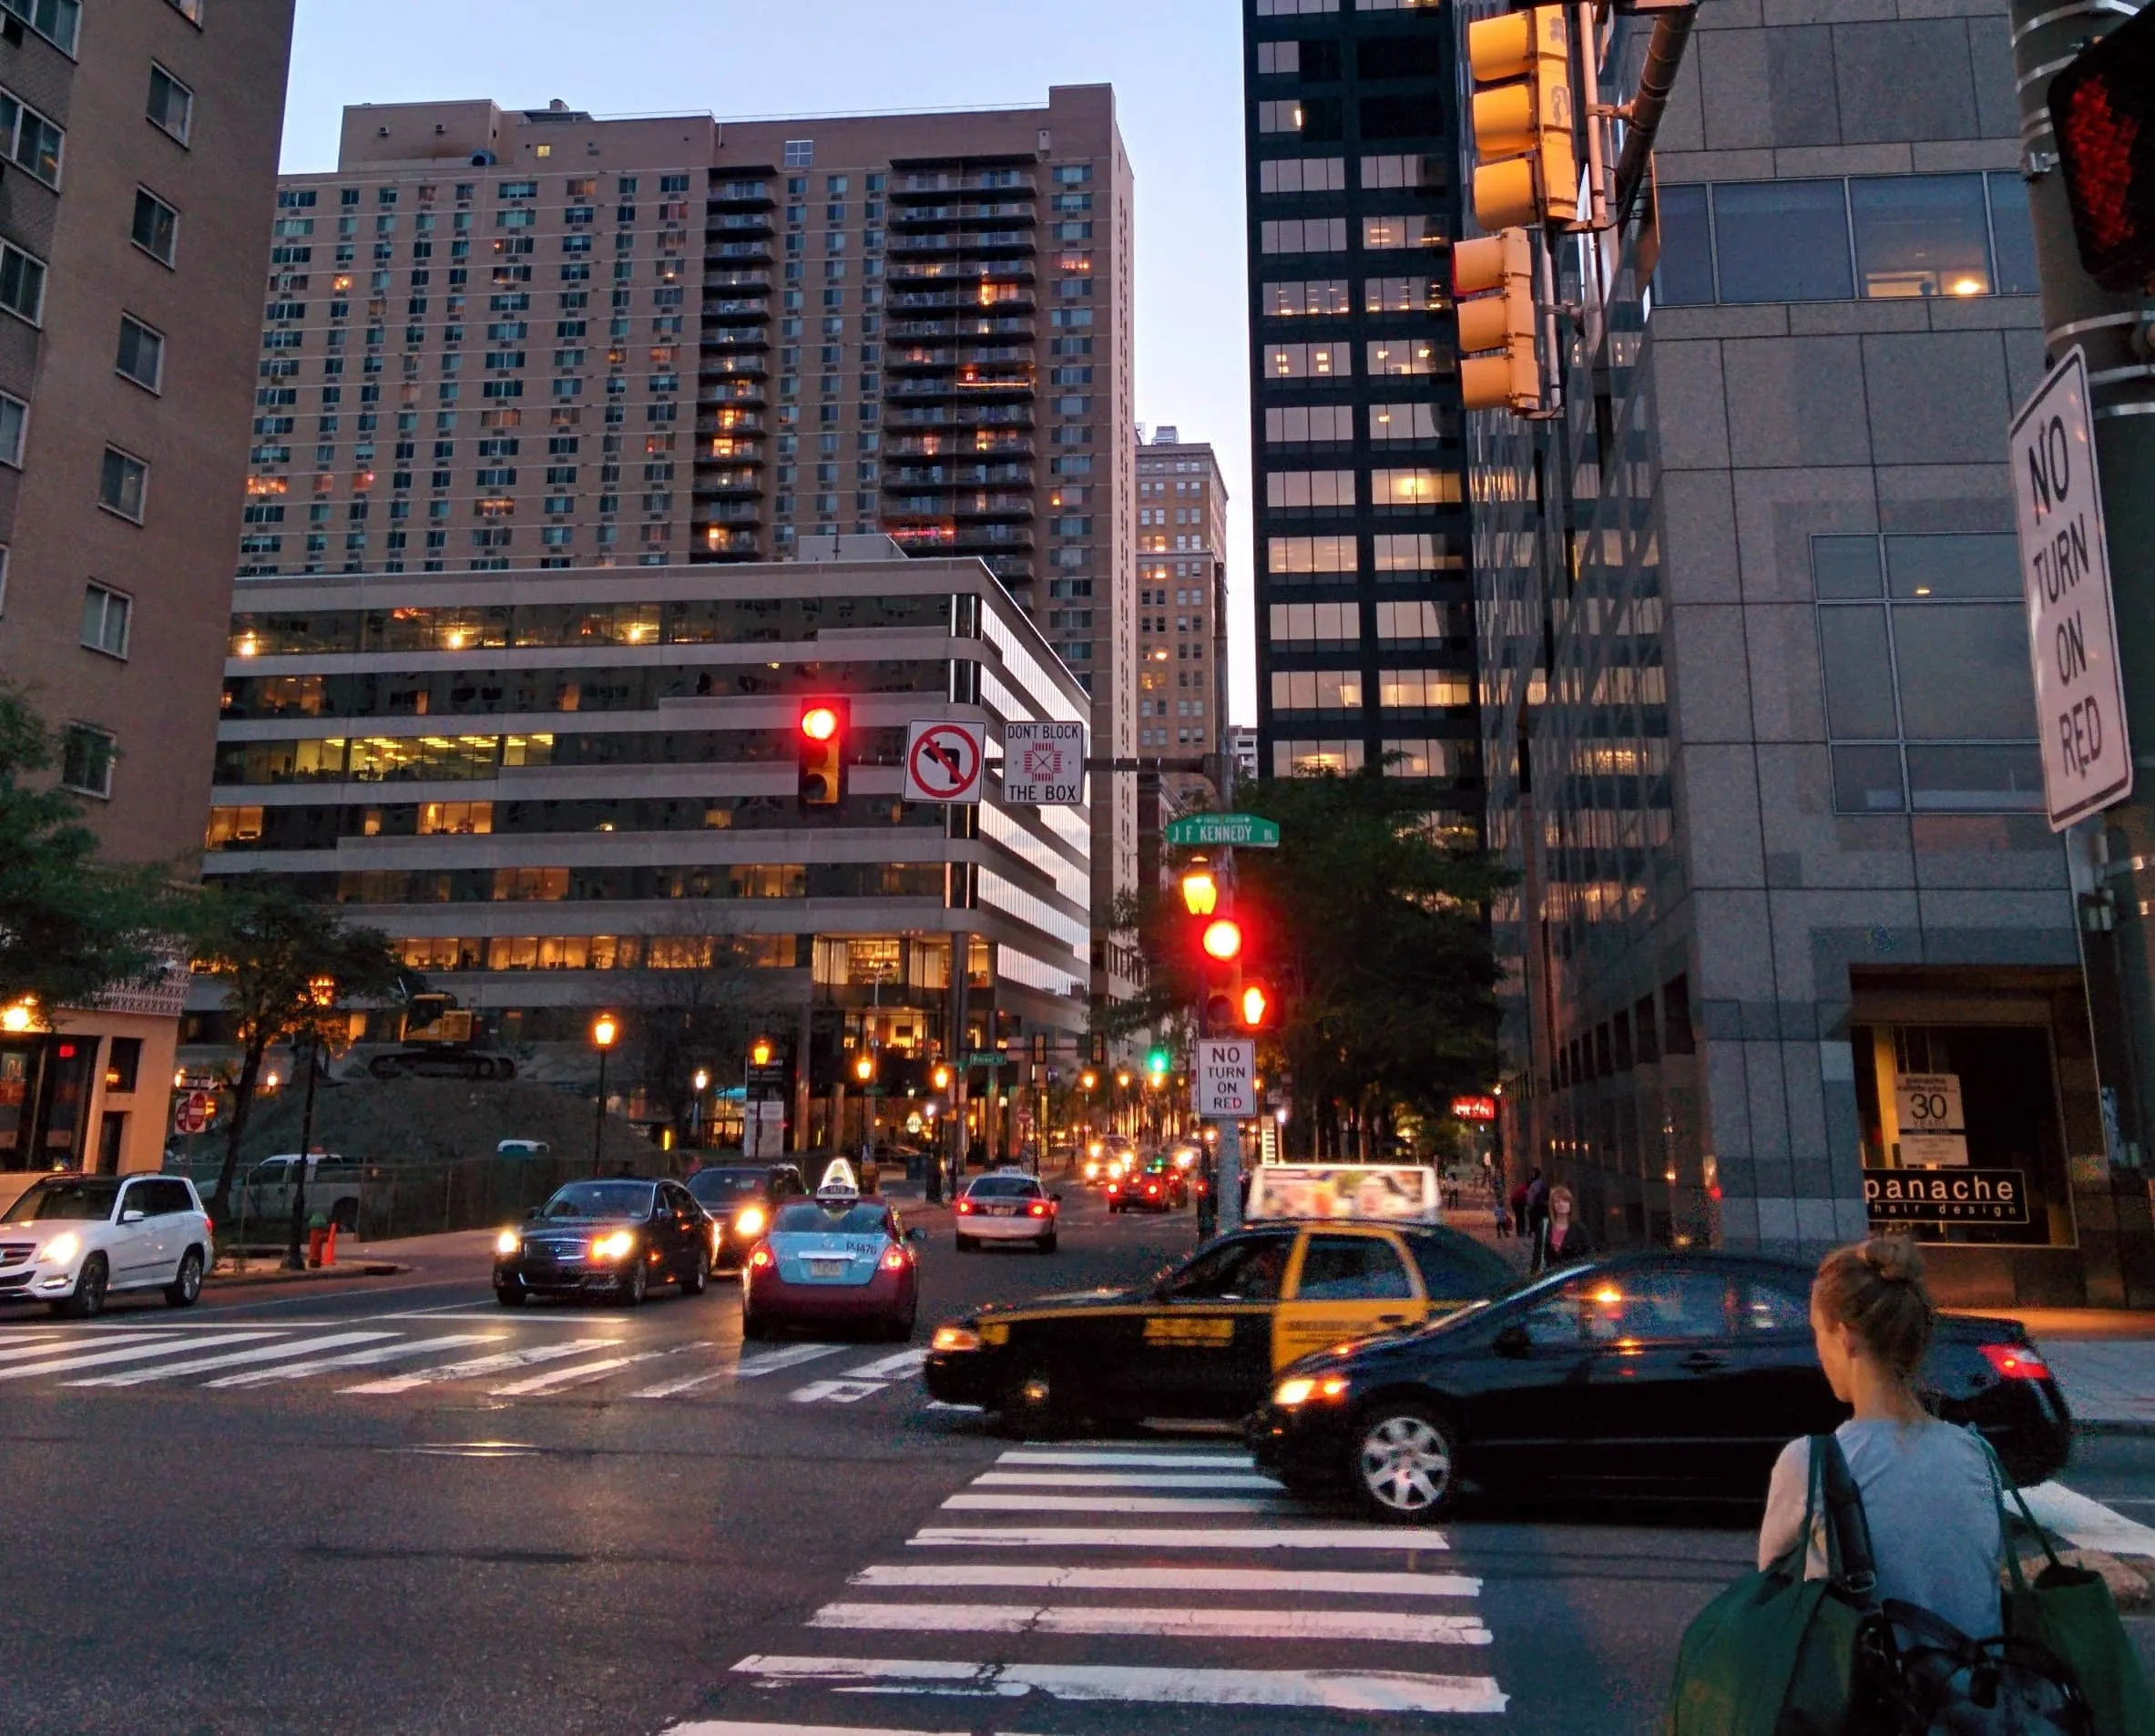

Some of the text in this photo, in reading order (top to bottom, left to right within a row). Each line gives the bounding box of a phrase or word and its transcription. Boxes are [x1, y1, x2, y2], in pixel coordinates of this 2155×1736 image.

[2028, 414, 2070, 526] NO
[2033, 513, 2090, 614] TURN
[2056, 610, 2086, 687] ON
[1042, 725, 1078, 740] BLOCK
[2059, 695, 2102, 778] RED
[1008, 784, 1076, 801] THE BOX
[1171, 825, 1180, 842] J
[1186, 825, 1193, 842] F
[1200, 825, 1252, 842] KENNEDY
[1212, 1047, 1240, 1064] NO
[1208, 1067, 1246, 1079] TURN
[1217, 1081, 1237, 1094] ON
[1213, 1097, 1242, 1109] RED
[1910, 1093, 1947, 1119] 30
[1864, 1174, 2014, 1204] panache
[1874, 1203, 2016, 1218] hair design
